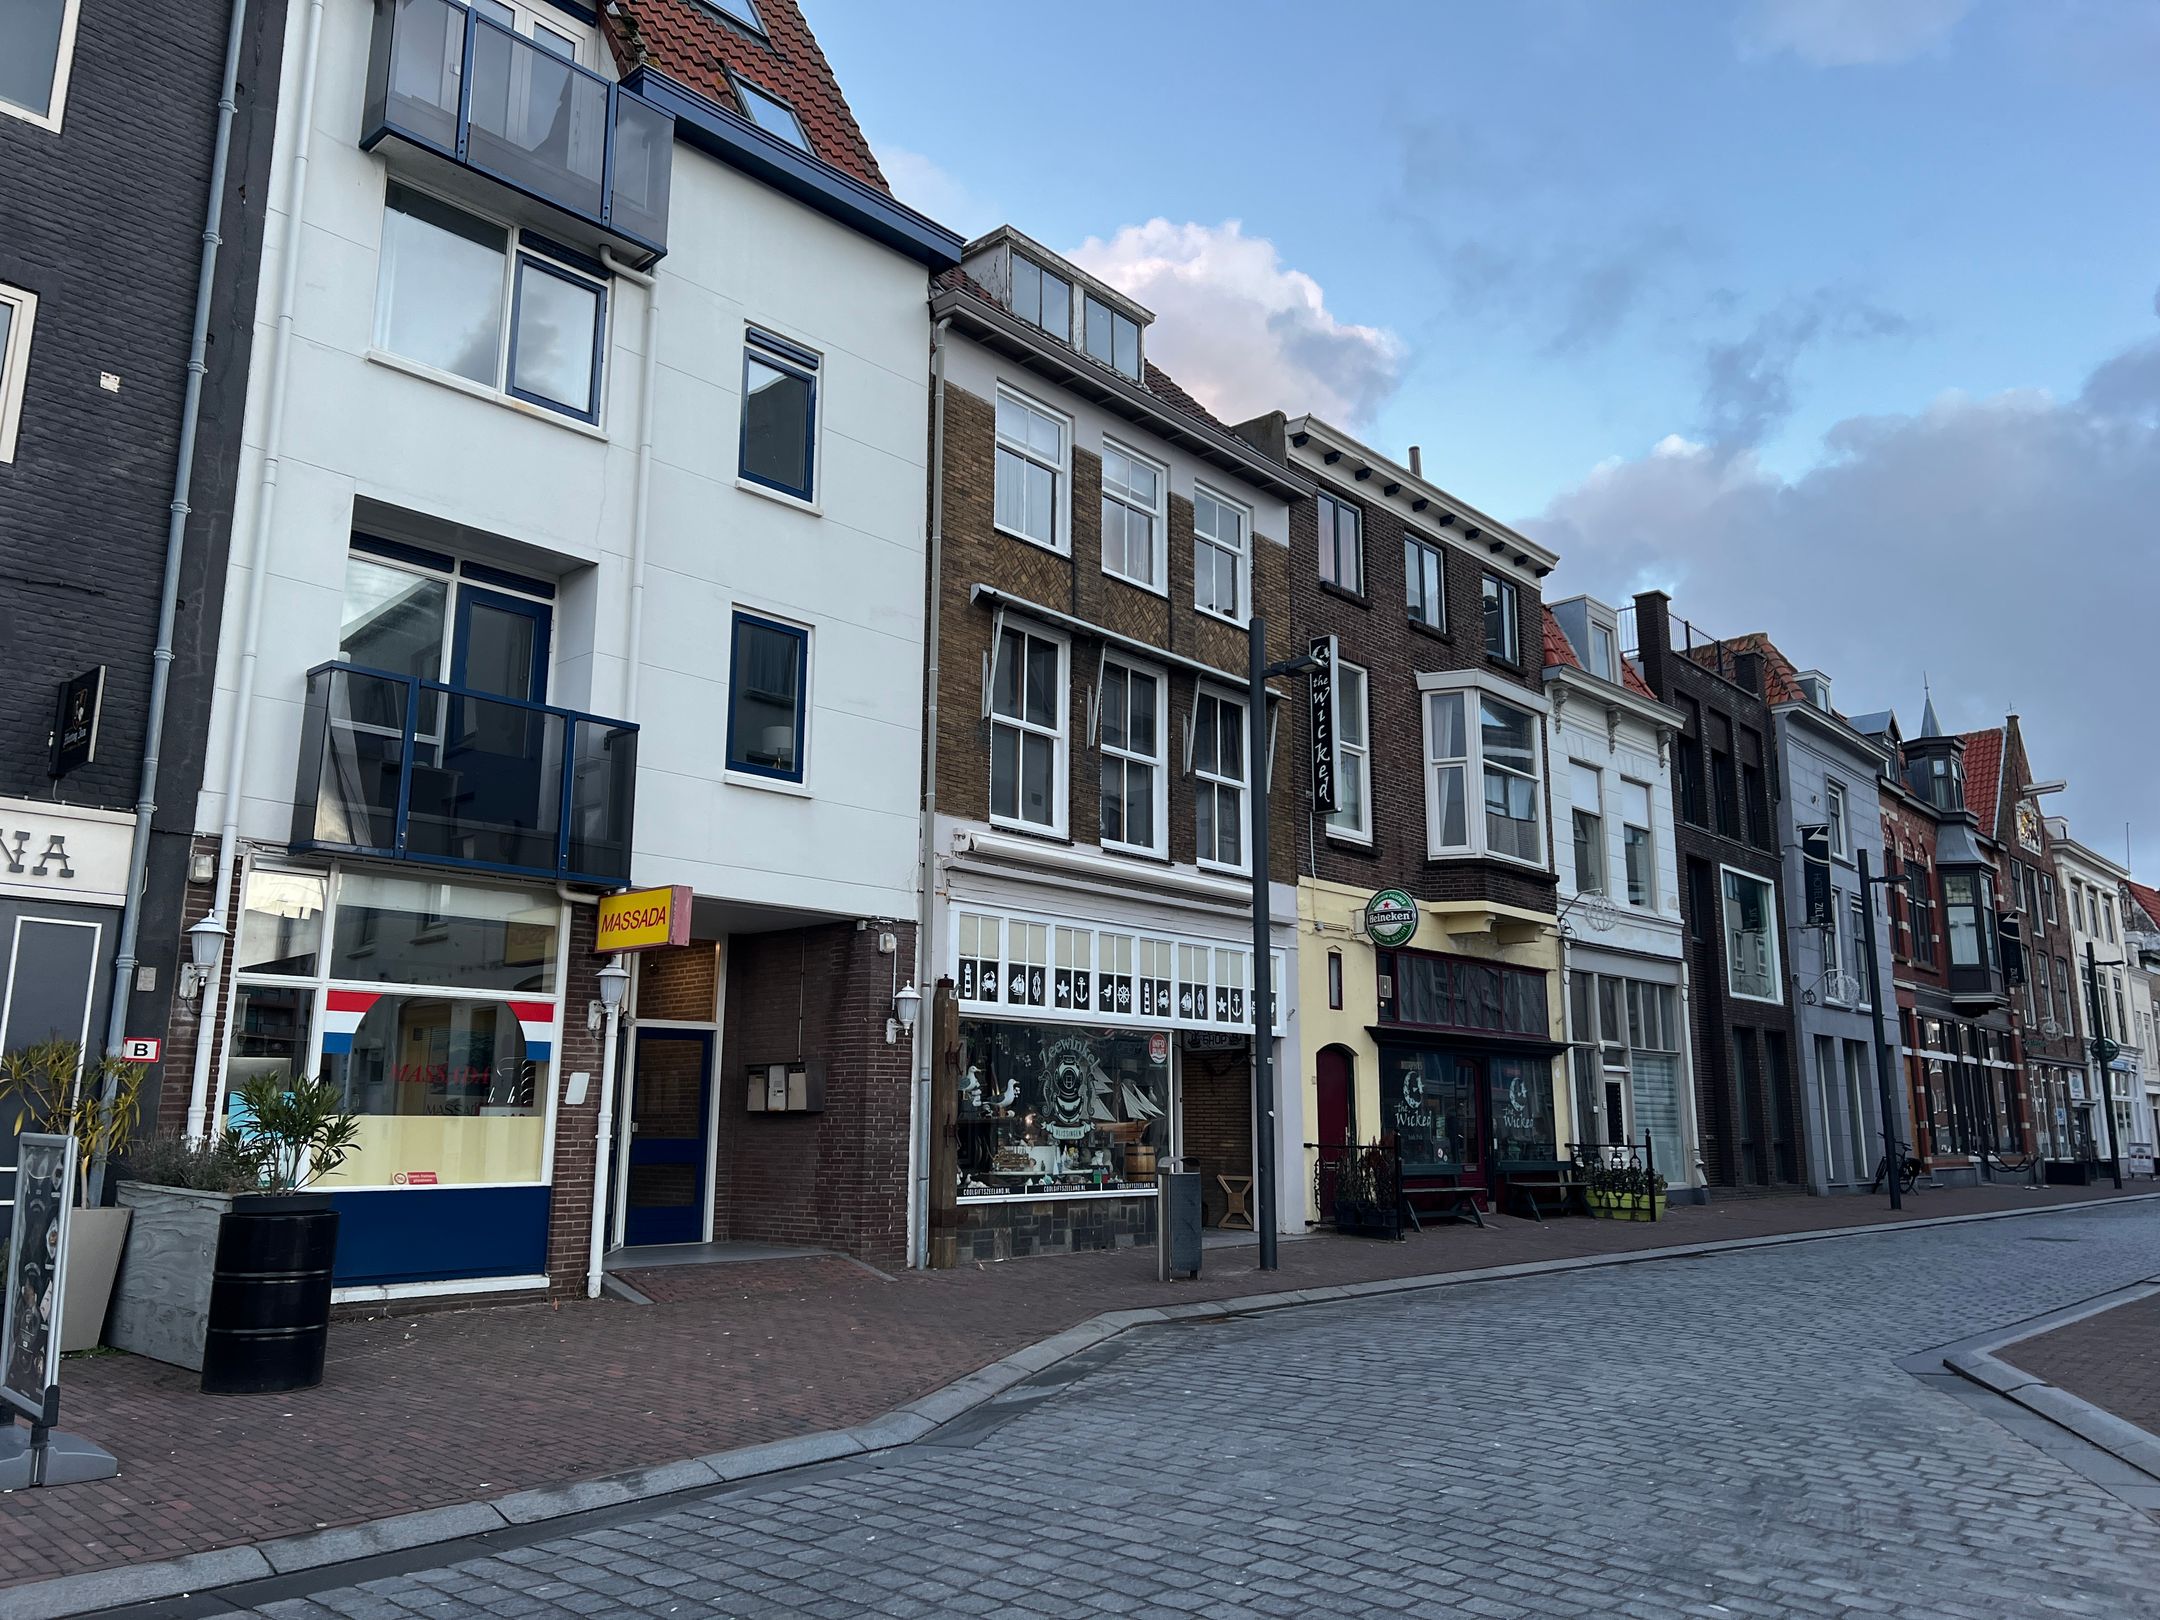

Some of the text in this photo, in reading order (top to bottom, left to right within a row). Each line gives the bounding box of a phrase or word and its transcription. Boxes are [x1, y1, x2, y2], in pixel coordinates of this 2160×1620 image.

[1313, 675, 1329, 688] the
[1313, 686, 1331, 802] Wicked
[1813, 873, 1825, 918] HOTEL ZILT
[601, 906, 667, 933] MASSADA
[1369, 911, 1410, 924] Heineken
[1152, 1039, 1165, 1048] INFO
[1202, 1034, 1227, 1046] SHOP
[134, 1043, 148, 1056] B
[1038, 1034, 1101, 1070] Zeewinkel
[391, 1063, 491, 1085] MASSADA
[1394, 1100, 1408, 1113] the
[1395, 1110, 1432, 1127] Wicked
[1503, 1112, 1534, 1129] Wicked
[963, 1187, 1011, 1195] COOLGIFTSZEELAND.NL
[1043, 1185, 1086, 1193] COOLGIFTSZEELAND.NL
